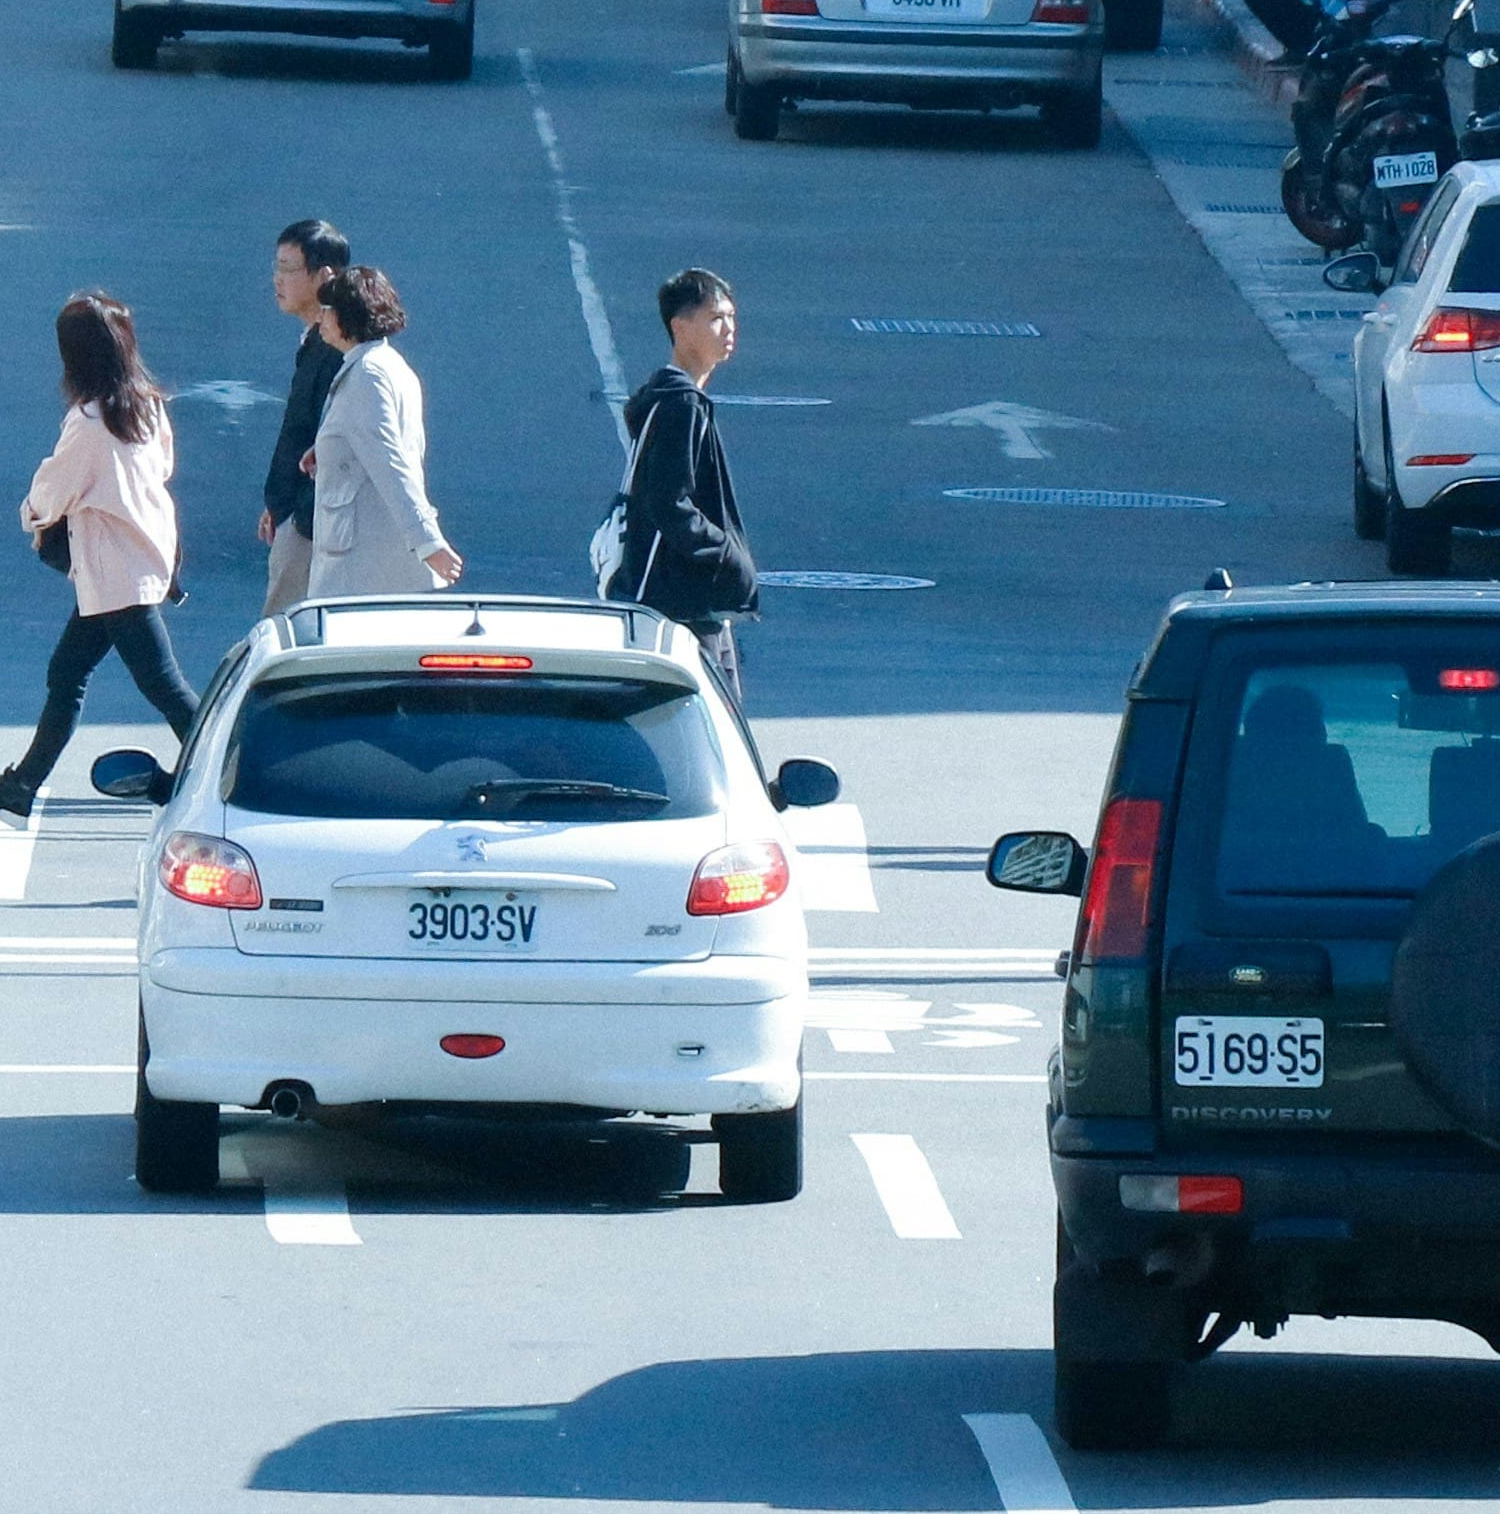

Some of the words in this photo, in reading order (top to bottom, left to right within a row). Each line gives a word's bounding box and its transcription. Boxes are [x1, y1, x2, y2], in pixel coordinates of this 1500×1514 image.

[408, 902, 537, 943] 3903-SV
[1177, 1031, 1322, 1076] 5169-S5
[1171, 1106, 1333, 1121] DISCOVERY
